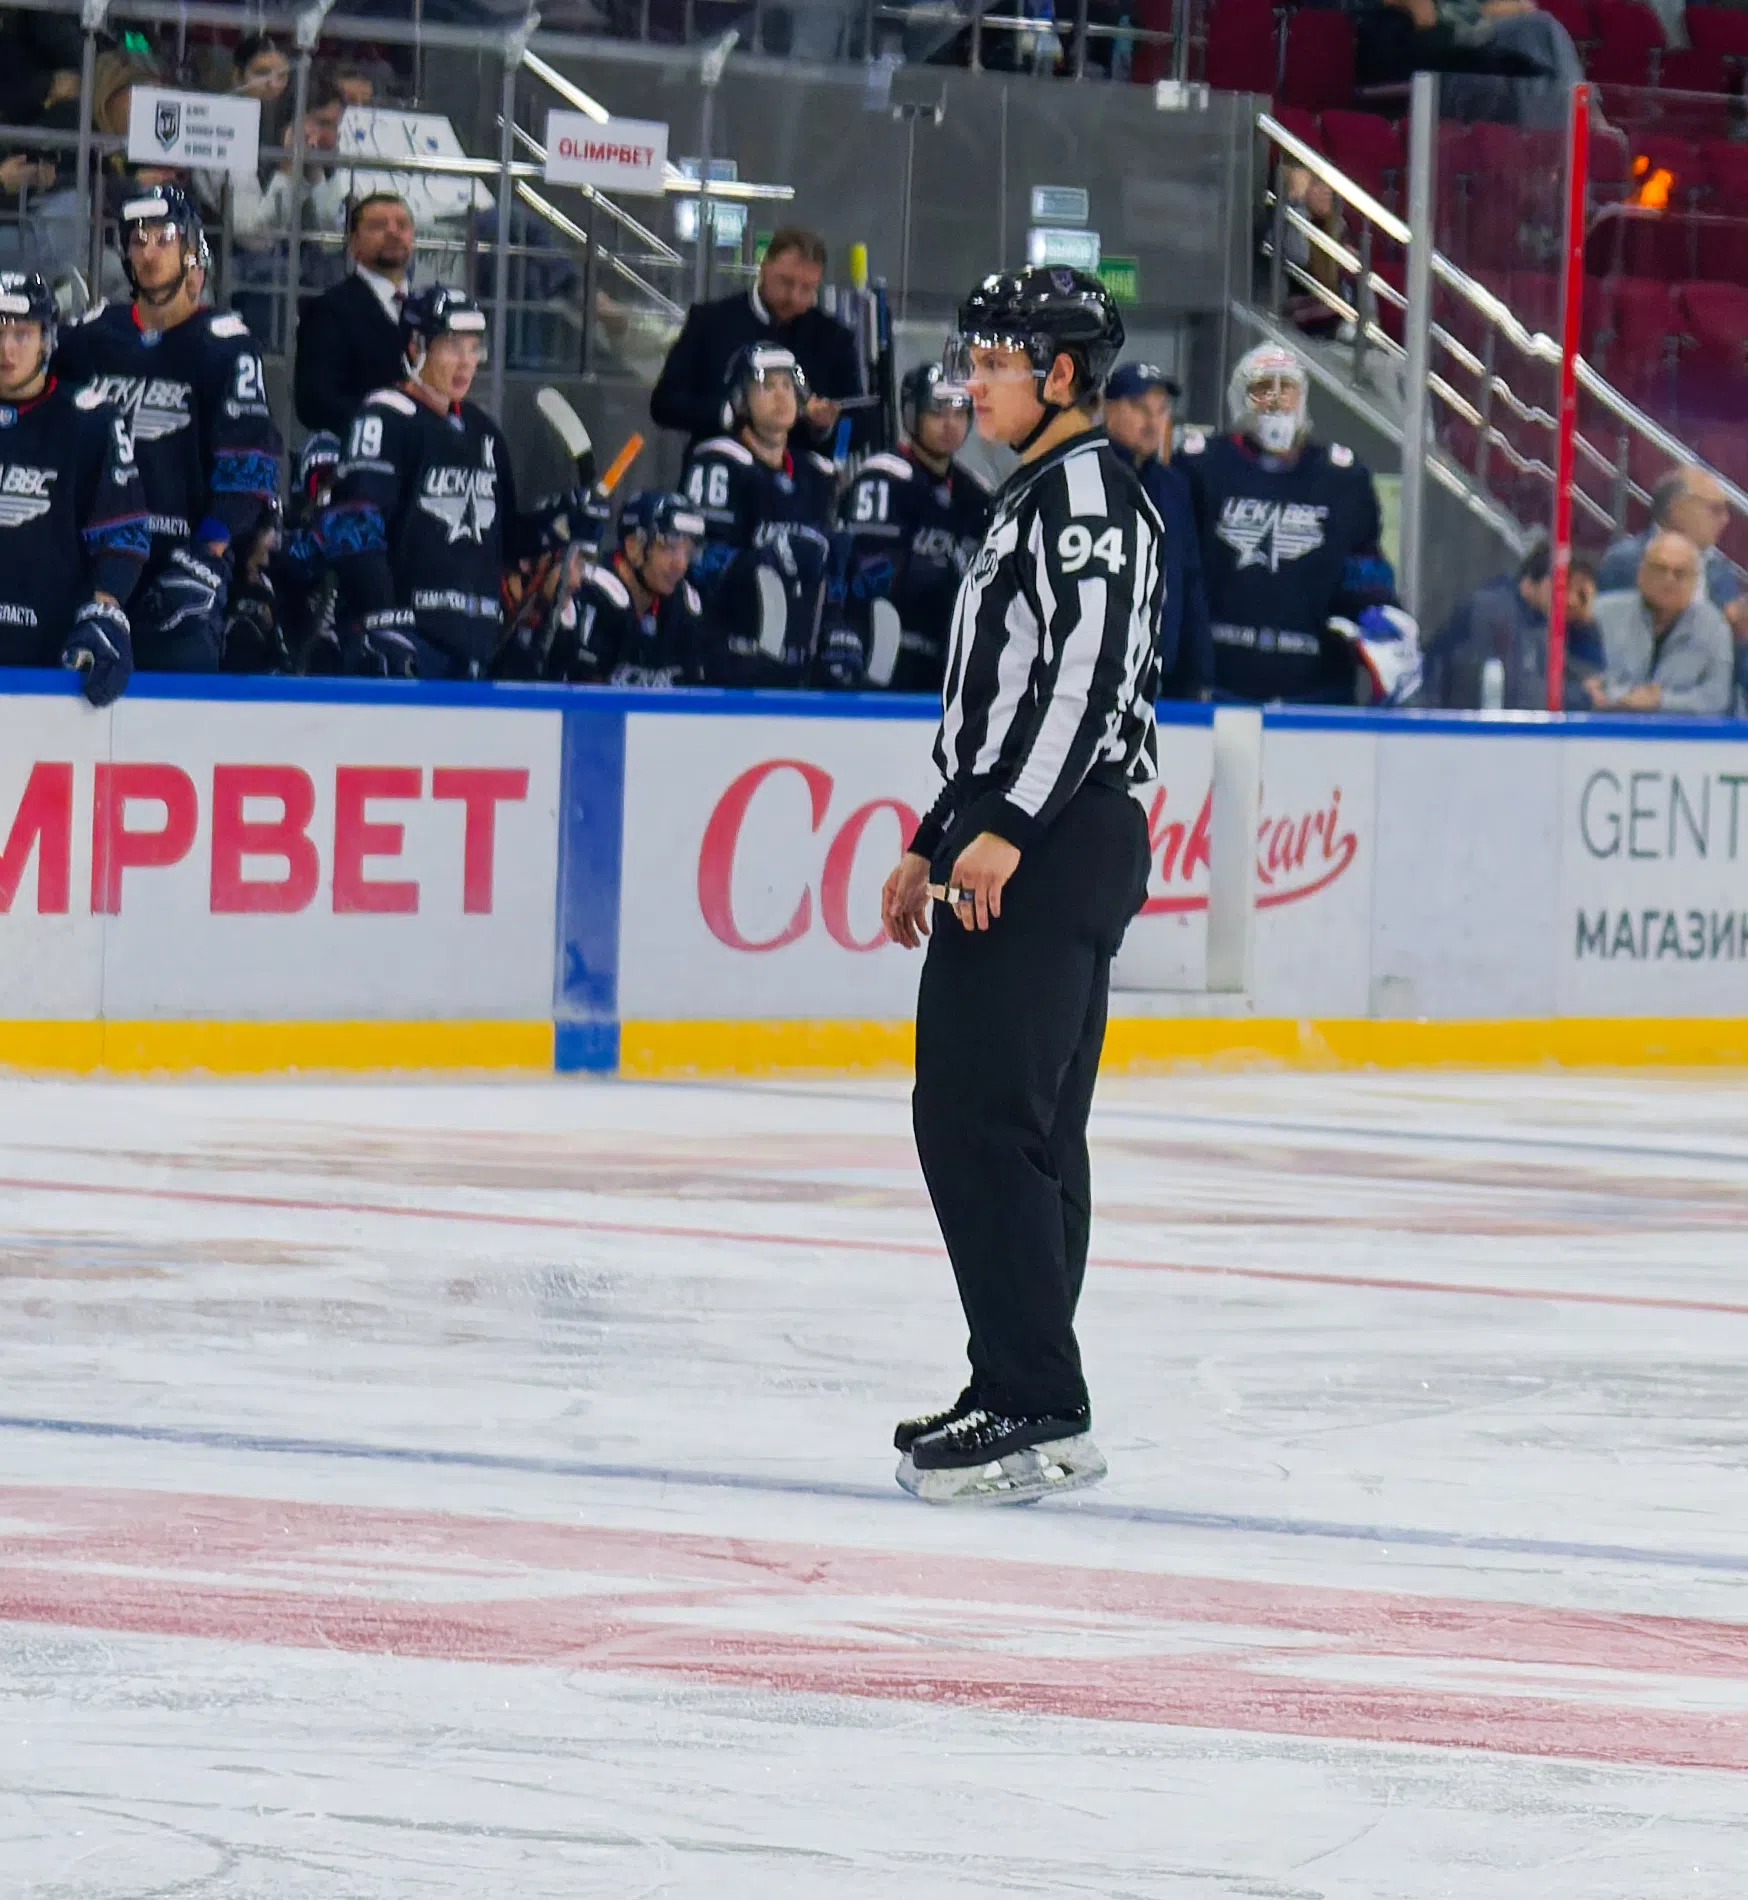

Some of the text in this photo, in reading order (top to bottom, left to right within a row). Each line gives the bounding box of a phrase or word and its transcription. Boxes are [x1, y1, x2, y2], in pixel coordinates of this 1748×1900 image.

[558, 137, 655, 168] OLIMPBET
[351, 414, 384, 458] 19
[687, 463, 729, 507] 46
[856, 478, 891, 522] 51
[1056, 525, 1127, 574] 94
